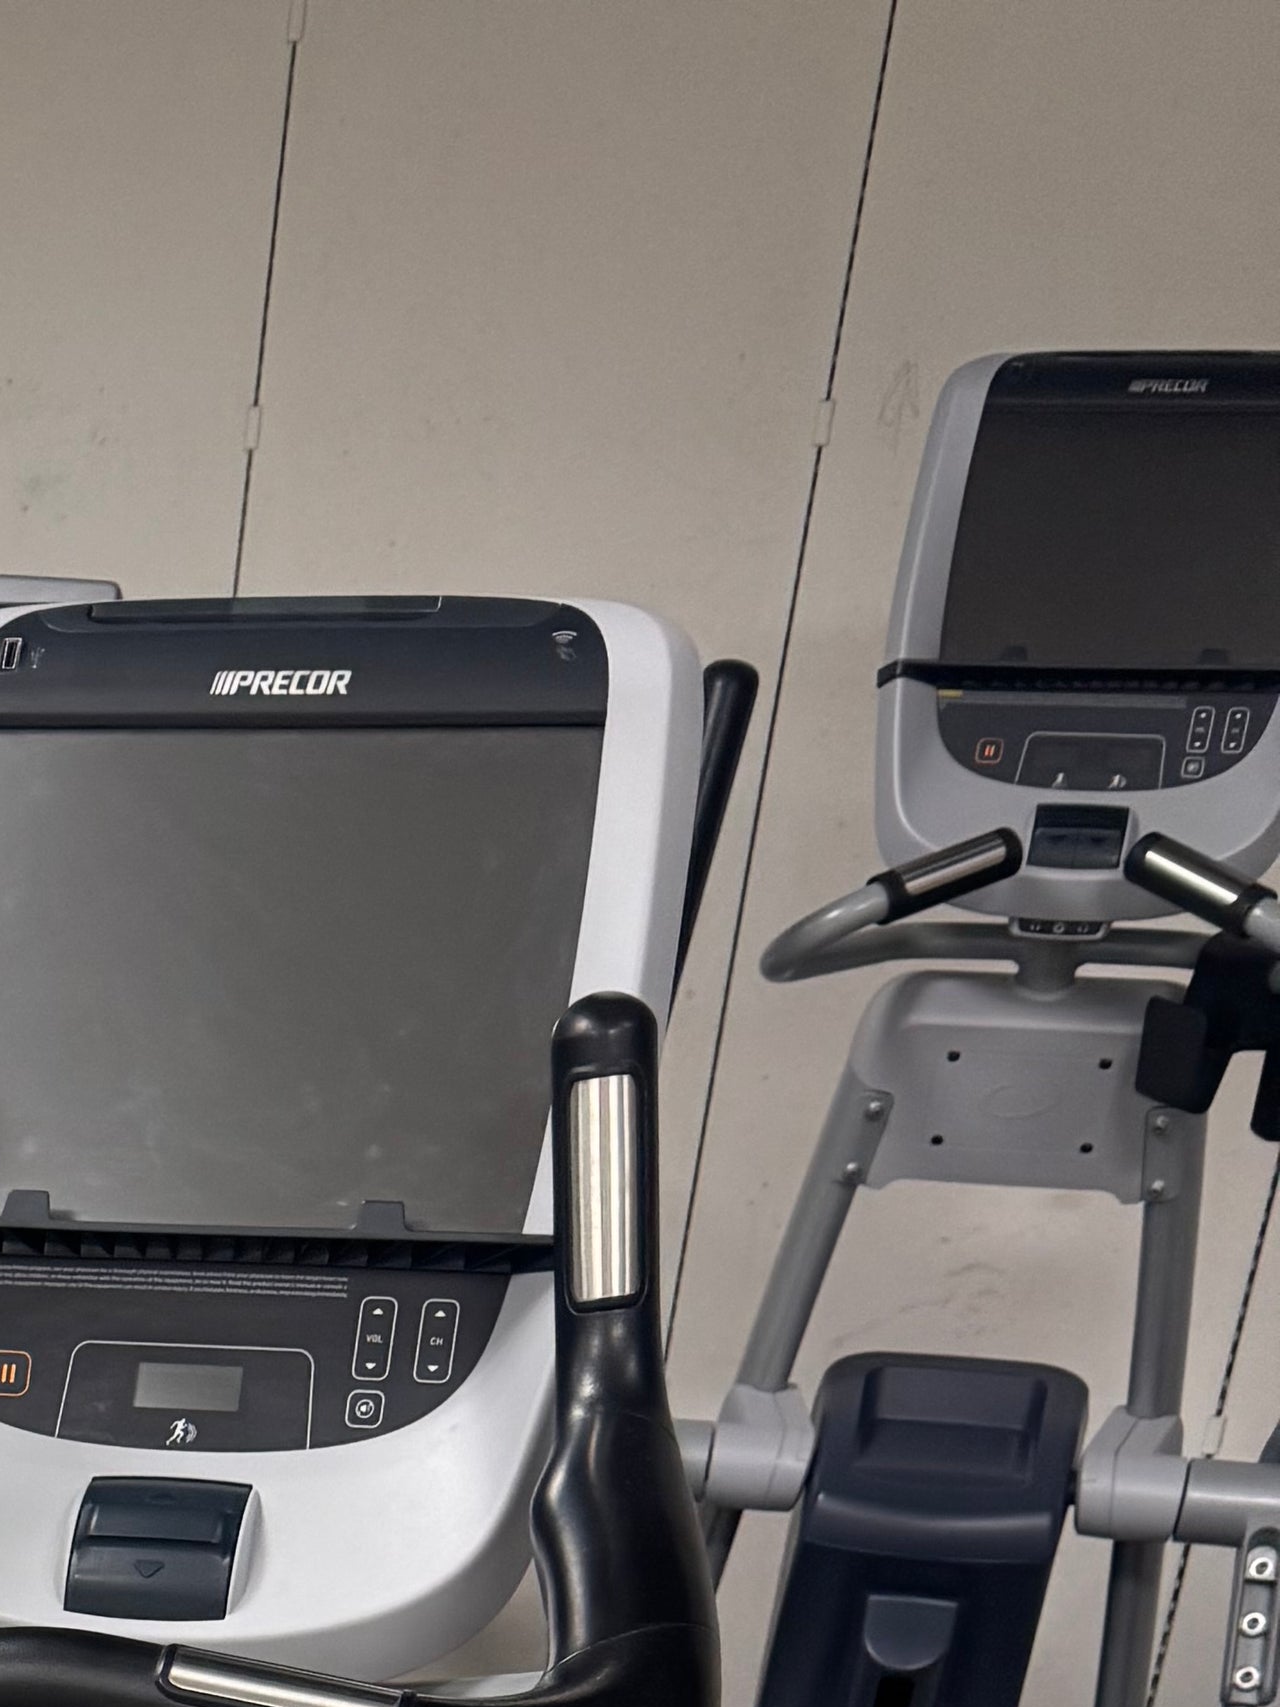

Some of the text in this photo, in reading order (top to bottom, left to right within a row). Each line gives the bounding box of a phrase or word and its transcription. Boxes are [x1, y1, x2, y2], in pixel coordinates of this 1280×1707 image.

[210, 670, 352, 695] PRECOR
[365, 1334, 383, 1344] VOL
[429, 1336, 444, 1346] CH
